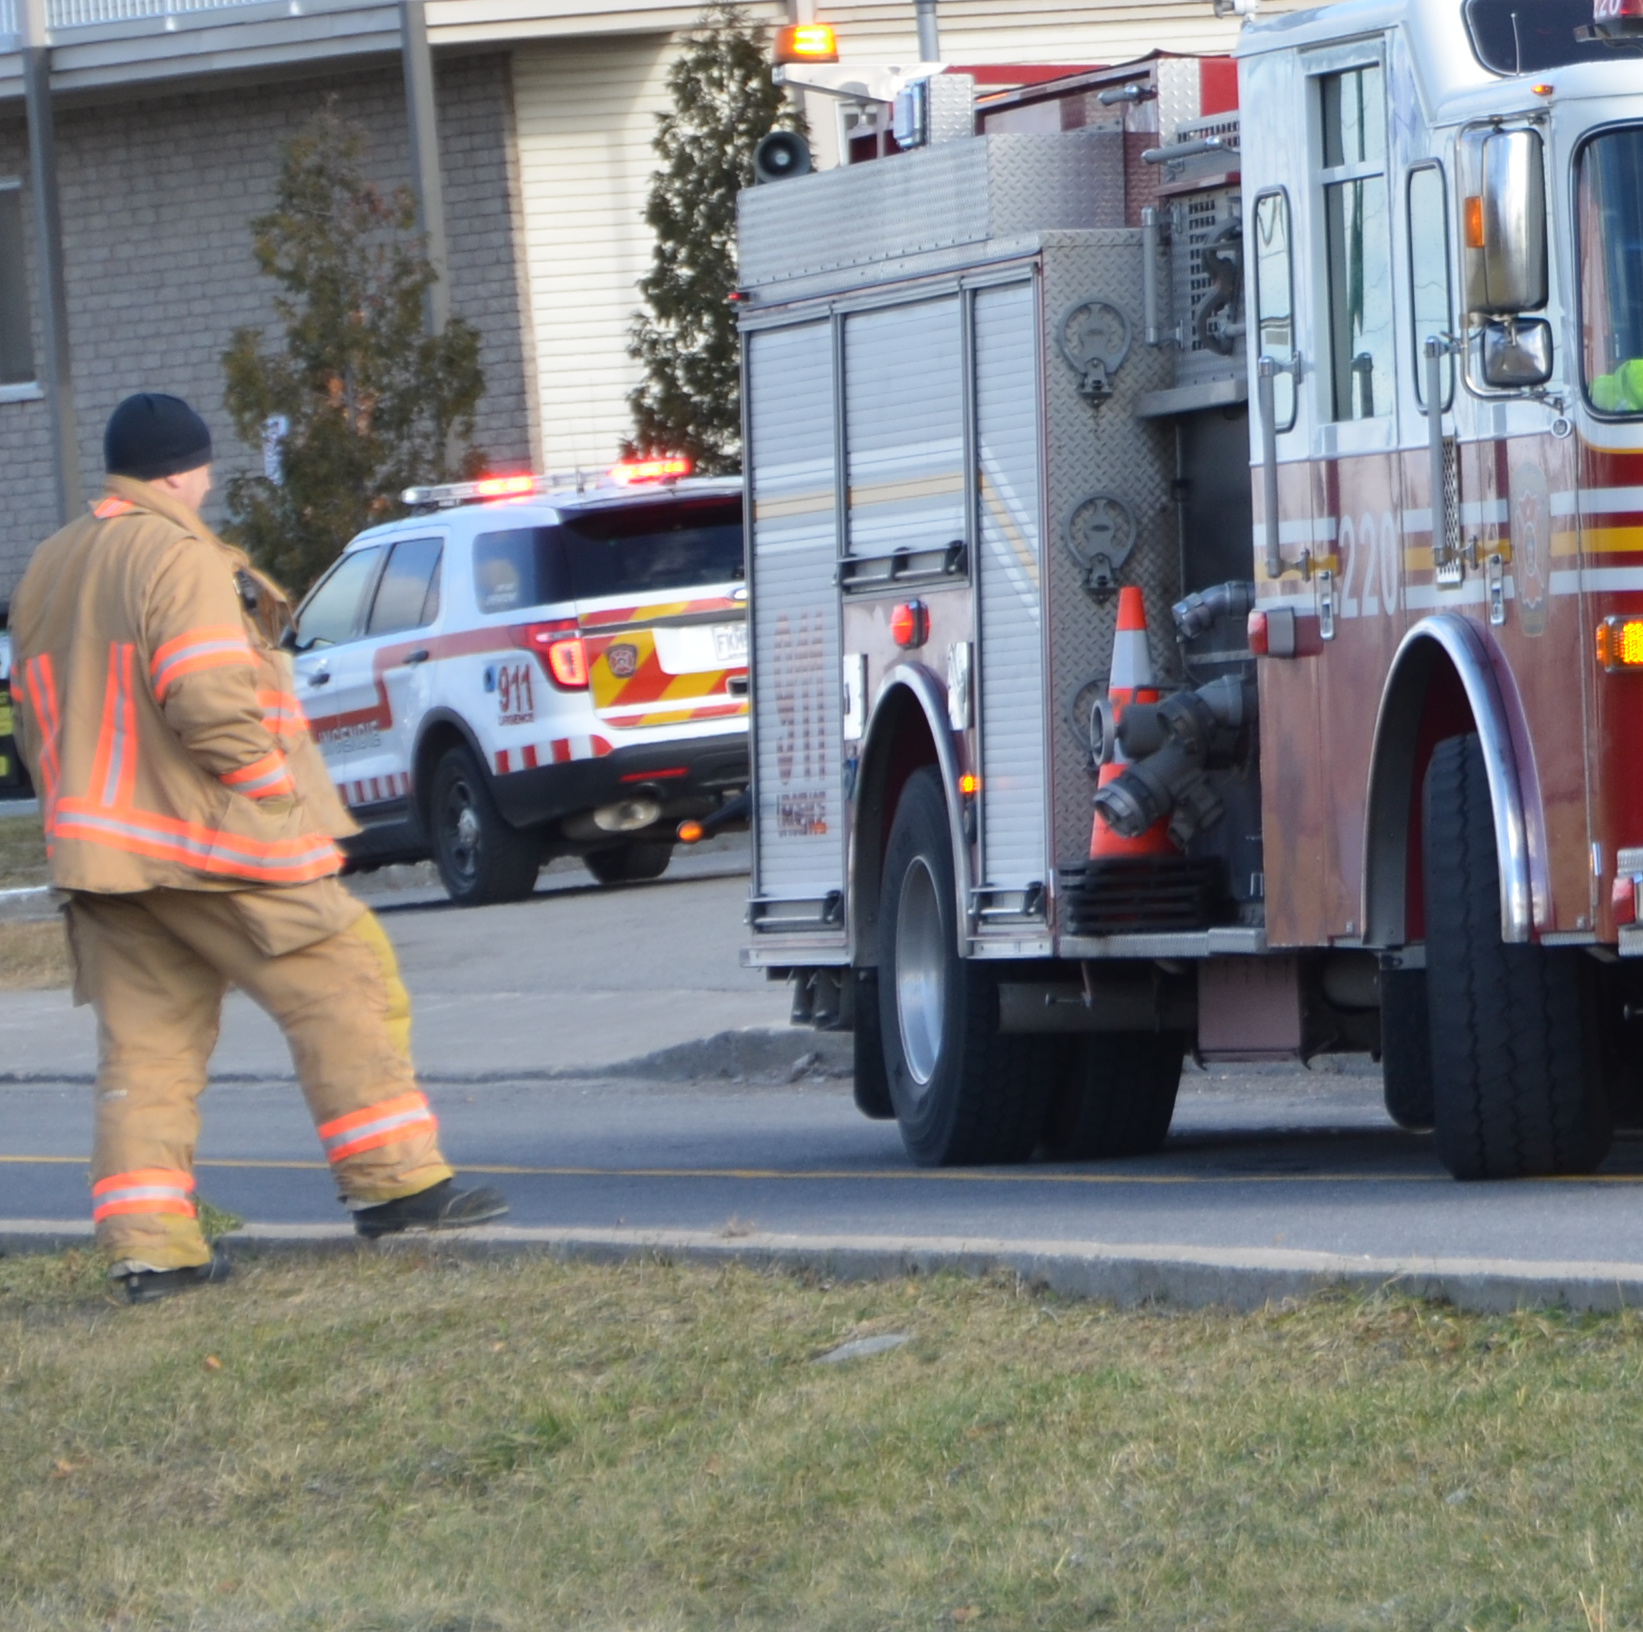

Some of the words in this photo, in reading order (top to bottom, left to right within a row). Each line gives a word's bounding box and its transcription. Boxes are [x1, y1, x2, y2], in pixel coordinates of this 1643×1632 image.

[1338, 511, 1398, 619] 220
[498, 664, 534, 713] 911
[774, 611, 826, 786] 911
